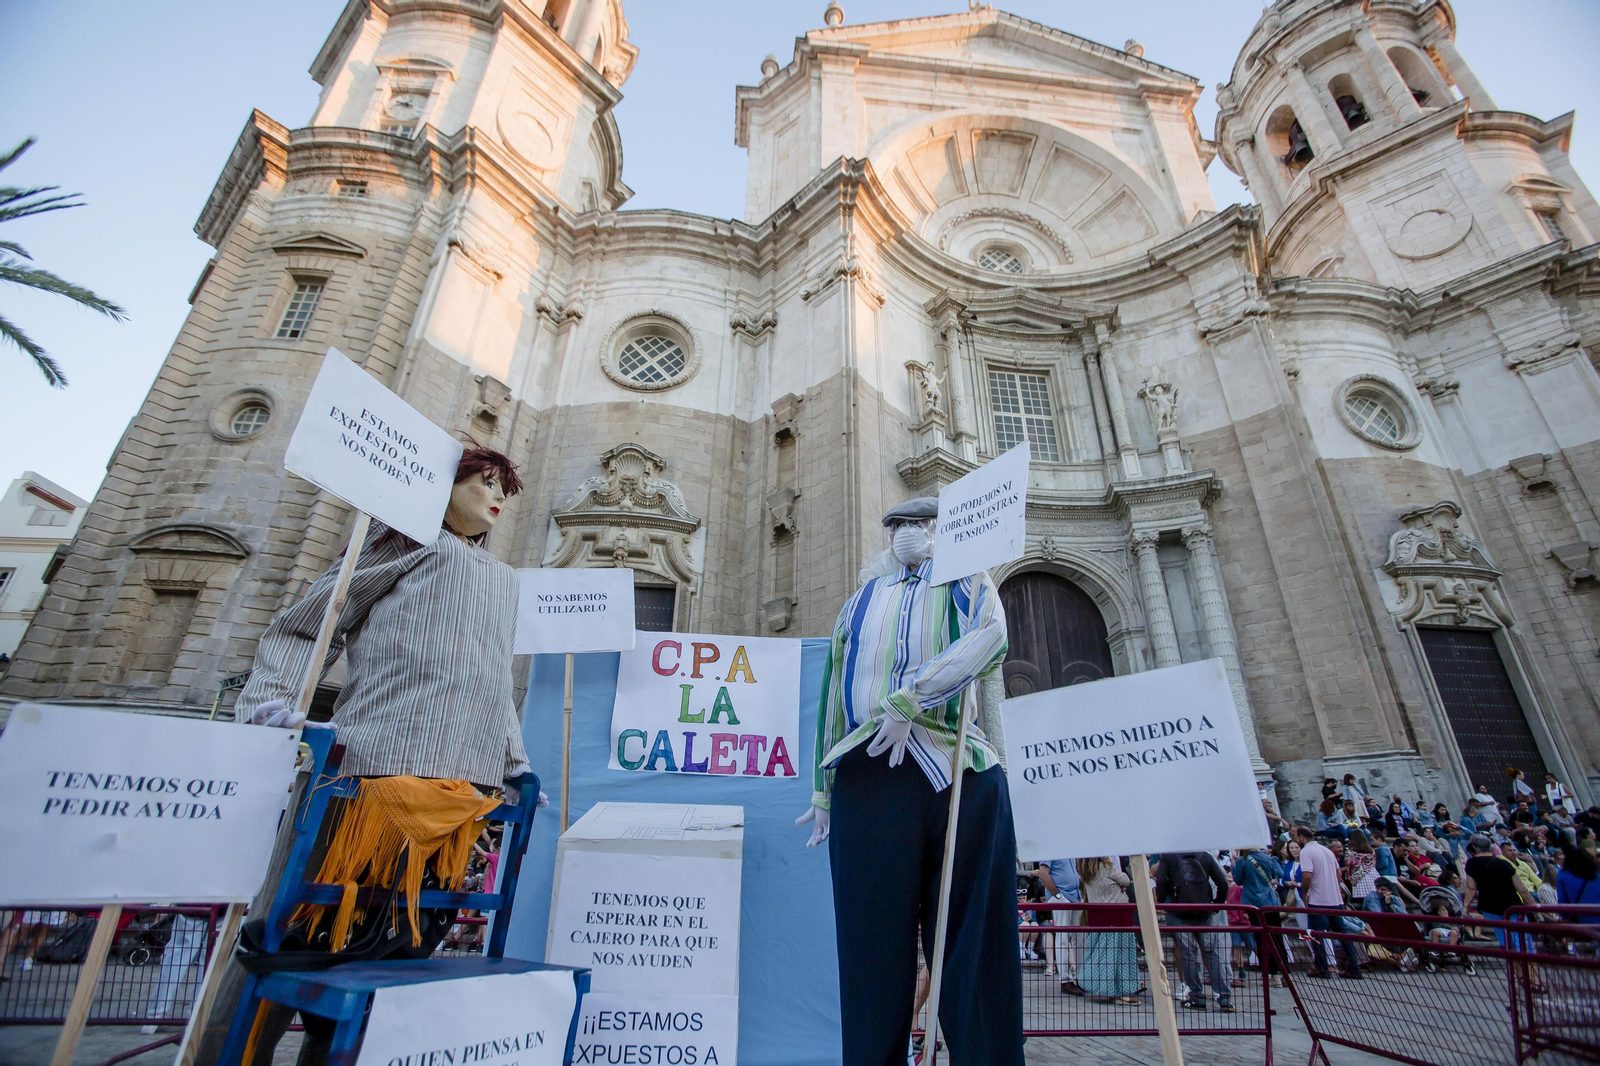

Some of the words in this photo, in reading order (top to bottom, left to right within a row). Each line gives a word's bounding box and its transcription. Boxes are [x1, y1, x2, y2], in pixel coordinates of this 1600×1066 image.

[329, 406, 398, 459] EXPUESTO
[399, 455, 408, 467] A
[410, 461, 436, 484] QUE
[360, 408, 419, 455] ESTAMOS
[338, 432, 368, 458] NOS
[368, 452, 413, 487] ROBEN
[947, 505, 959, 518] NO
[960, 485, 1001, 513] PODEMOS
[1002, 480, 1012, 494] NI
[940, 514, 974, 535] COBRAR
[976, 492, 1019, 522] NUESTRAS
[954, 516, 999, 543] PENSIONES
[537, 594, 553, 603] NO
[555, 592, 608, 602] SABEMOS
[538, 603, 607, 614] UTILIZARLO
[678, 684, 740, 725] LA
[1021, 731, 1116, 760] TENEMOS
[1120, 716, 1192, 745] MIEDO
[1198, 714, 1215, 732] A
[617, 729, 797, 776] CALETA
[1023, 762, 1063, 785] QUE
[1068, 756, 1109, 777] NOS
[1113, 738, 1220, 770] ENGAÑEN
[47, 770, 181, 794] TENEMOS
[187, 778, 239, 798] QUE
[42, 797, 130, 818] PEDIR
[134, 802, 222, 820] AYUDA
[591, 891, 669, 909] TENEMOS
[672, 895, 706, 911] QUE
[585, 911, 658, 928] ESPERAR
[662, 914, 684, 929] EN
[688, 916, 709, 930] EL
[570, 930, 635, 946] CAJERO
[639, 933, 681, 948] PARA
[685, 935, 718, 952] QUE
[591, 951, 624, 966] NOS
[627, 954, 694, 969] AYUDEN
[583, 1011, 703, 1035] ¡¡ESTAMOS
[462, 1035, 521, 1064] PIENSA
[525, 1030, 545, 1049] EN
[573, 1044, 697, 1065] XPUESTOS
[704, 1046, 719, 1065] A
